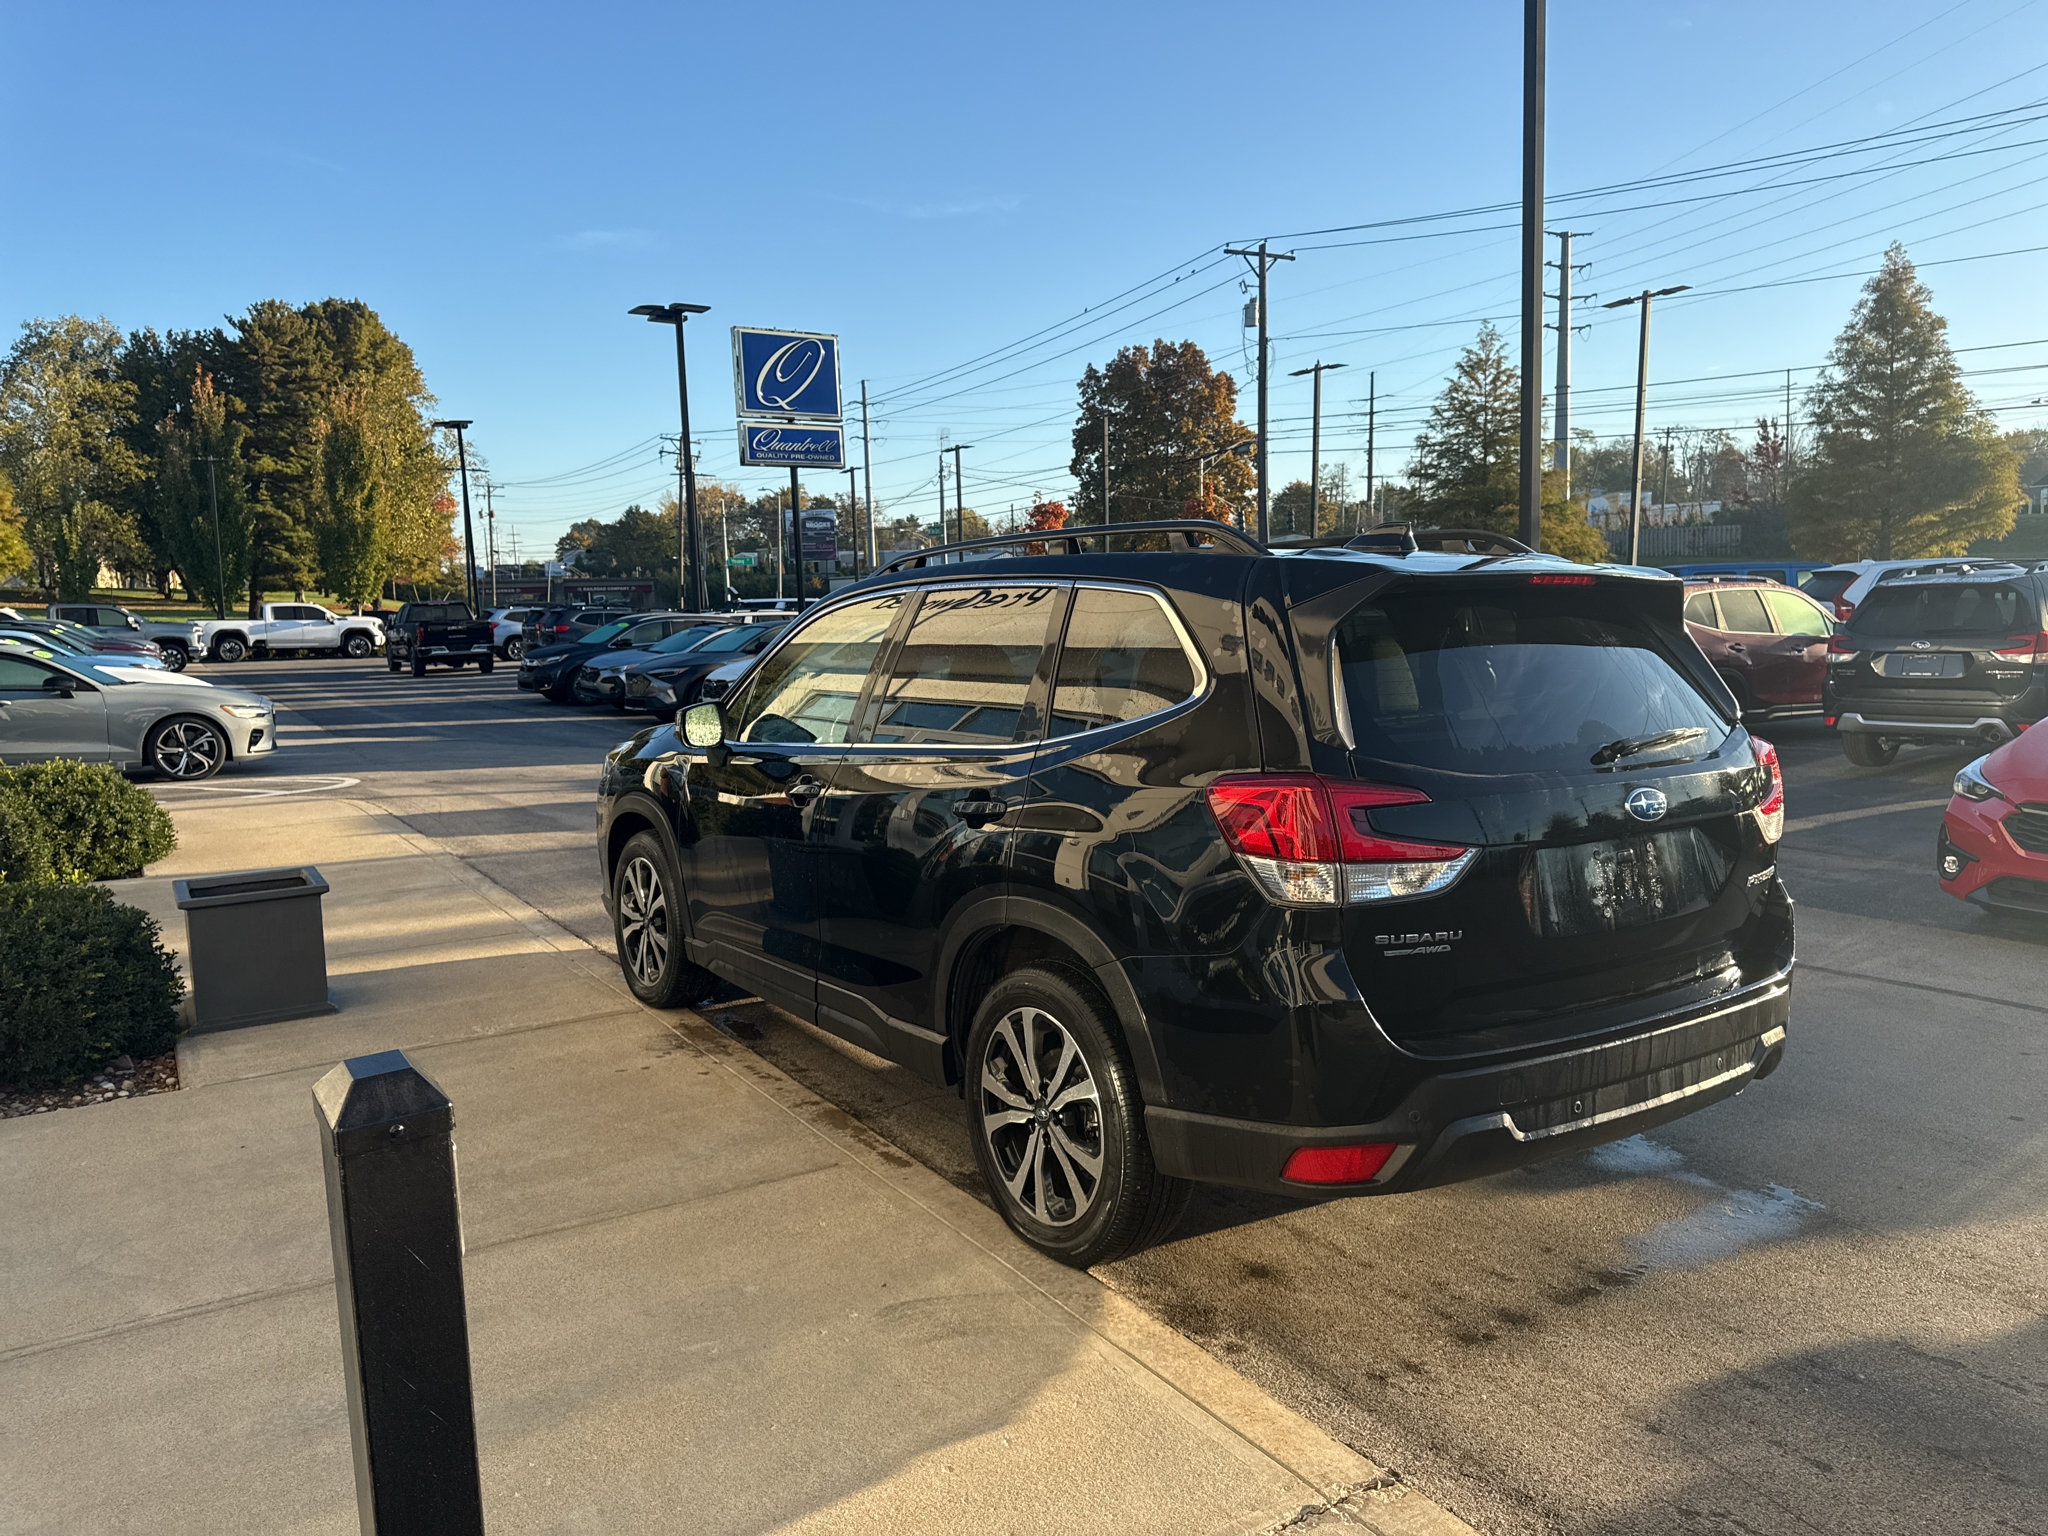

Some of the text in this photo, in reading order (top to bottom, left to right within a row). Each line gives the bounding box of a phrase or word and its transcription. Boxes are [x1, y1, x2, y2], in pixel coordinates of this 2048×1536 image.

[756, 338, 825, 410] Q
[753, 428, 837, 452] Quantrell
[790, 453, 835, 461] PRE-OWNED
[1375, 930, 1462, 944] SUBARU
[1411, 944, 1452, 955] AWD
